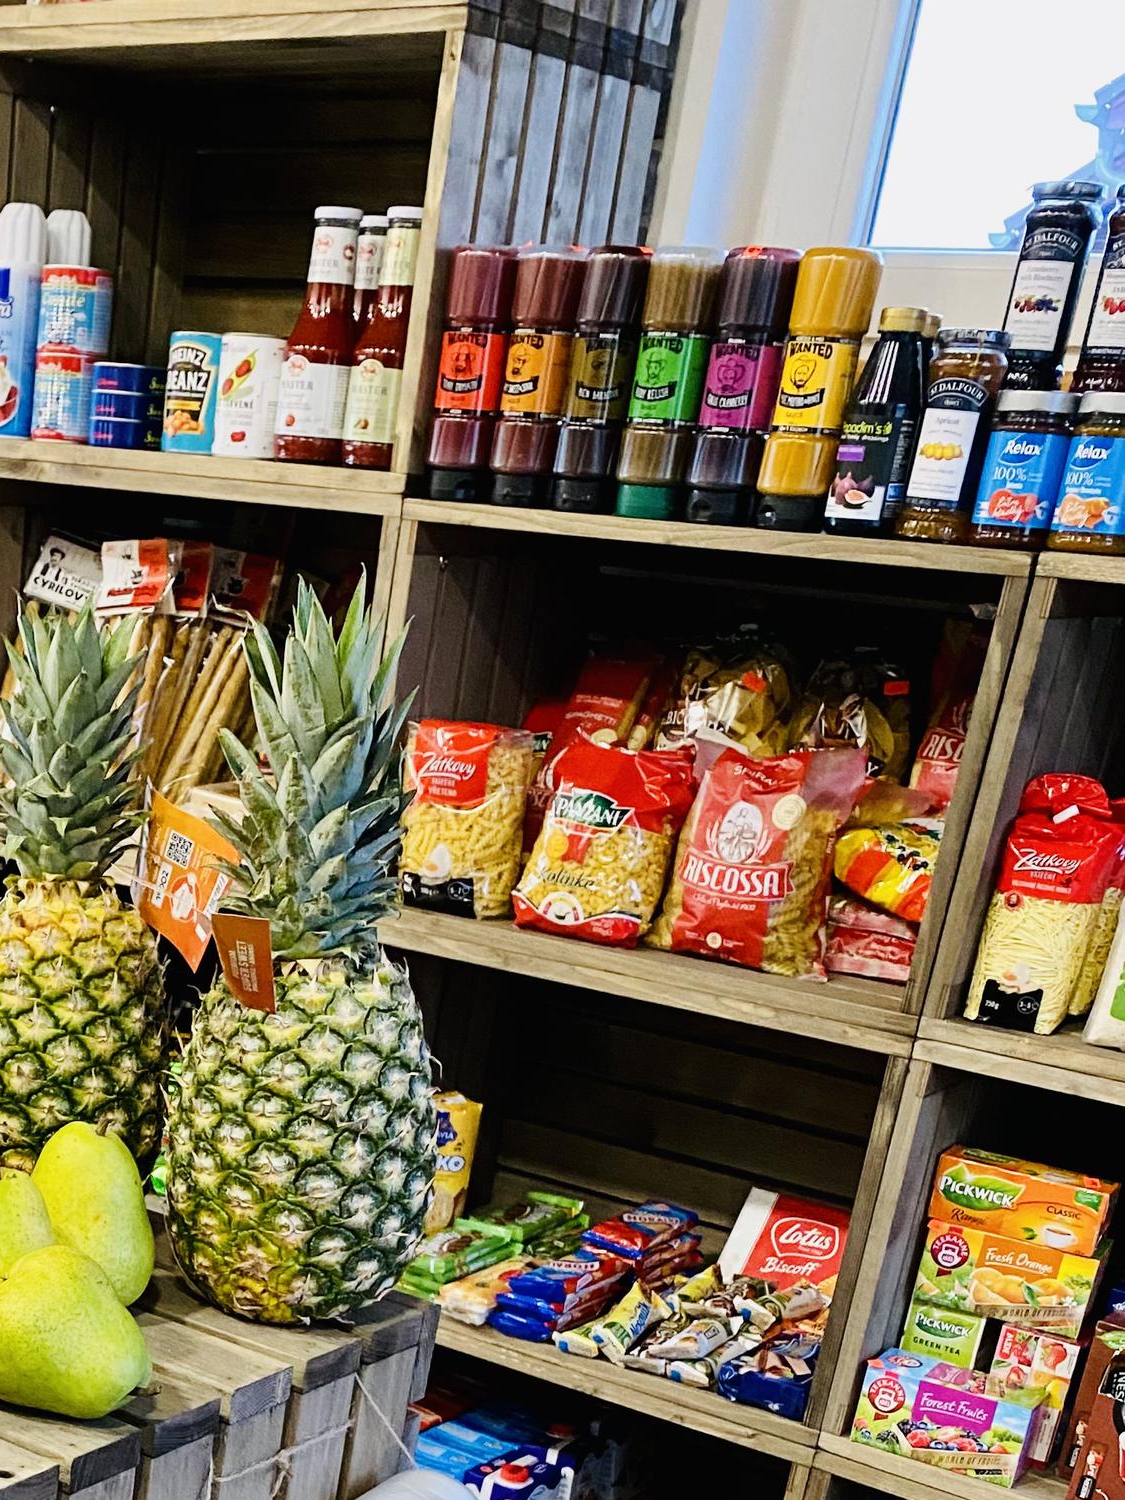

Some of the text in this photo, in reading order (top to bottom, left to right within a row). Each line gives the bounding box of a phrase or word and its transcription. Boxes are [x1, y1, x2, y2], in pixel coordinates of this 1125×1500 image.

[1034, 231, 1079, 250] DALFOUR
[642, 337, 684, 354] WANTED
[715, 344, 760, 361] WANTED
[789, 342, 833, 360] WANTED
[171, 346, 207, 367] HEINZ
[939, 381, 984, 401] DALFOUR
[1004, 440, 1043, 456] Relax
[1075, 444, 1109, 460] Relax
[993, 466, 1027, 481] 100%
[1065, 471, 1094, 485] 100%
[419, 752, 476, 781] Zátkovy
[555, 797, 623, 827] PANZANI
[1013, 848, 1082, 875] Zátkovy
[683, 855, 780, 897] RISCOSSA
[436, 1155, 466, 1173] KO
[939, 1176, 1014, 1208] PICKWICK
[1046, 1205, 1082, 1220] CLASSIC
[779, 1223, 833, 1250] Lotus
[932, 1234, 969, 1257] TEEKANNE
[759, 1256, 823, 1276] Biscoff
[985, 1247, 1053, 1275] Fresh Orange
[915, 1313, 970, 1337] PICKWICK
[912, 1336, 961, 1356] GREEN TEA
[869, 1379, 905, 1403] TEEKANNE
[920, 1392, 989, 1421] Forest Fruits
